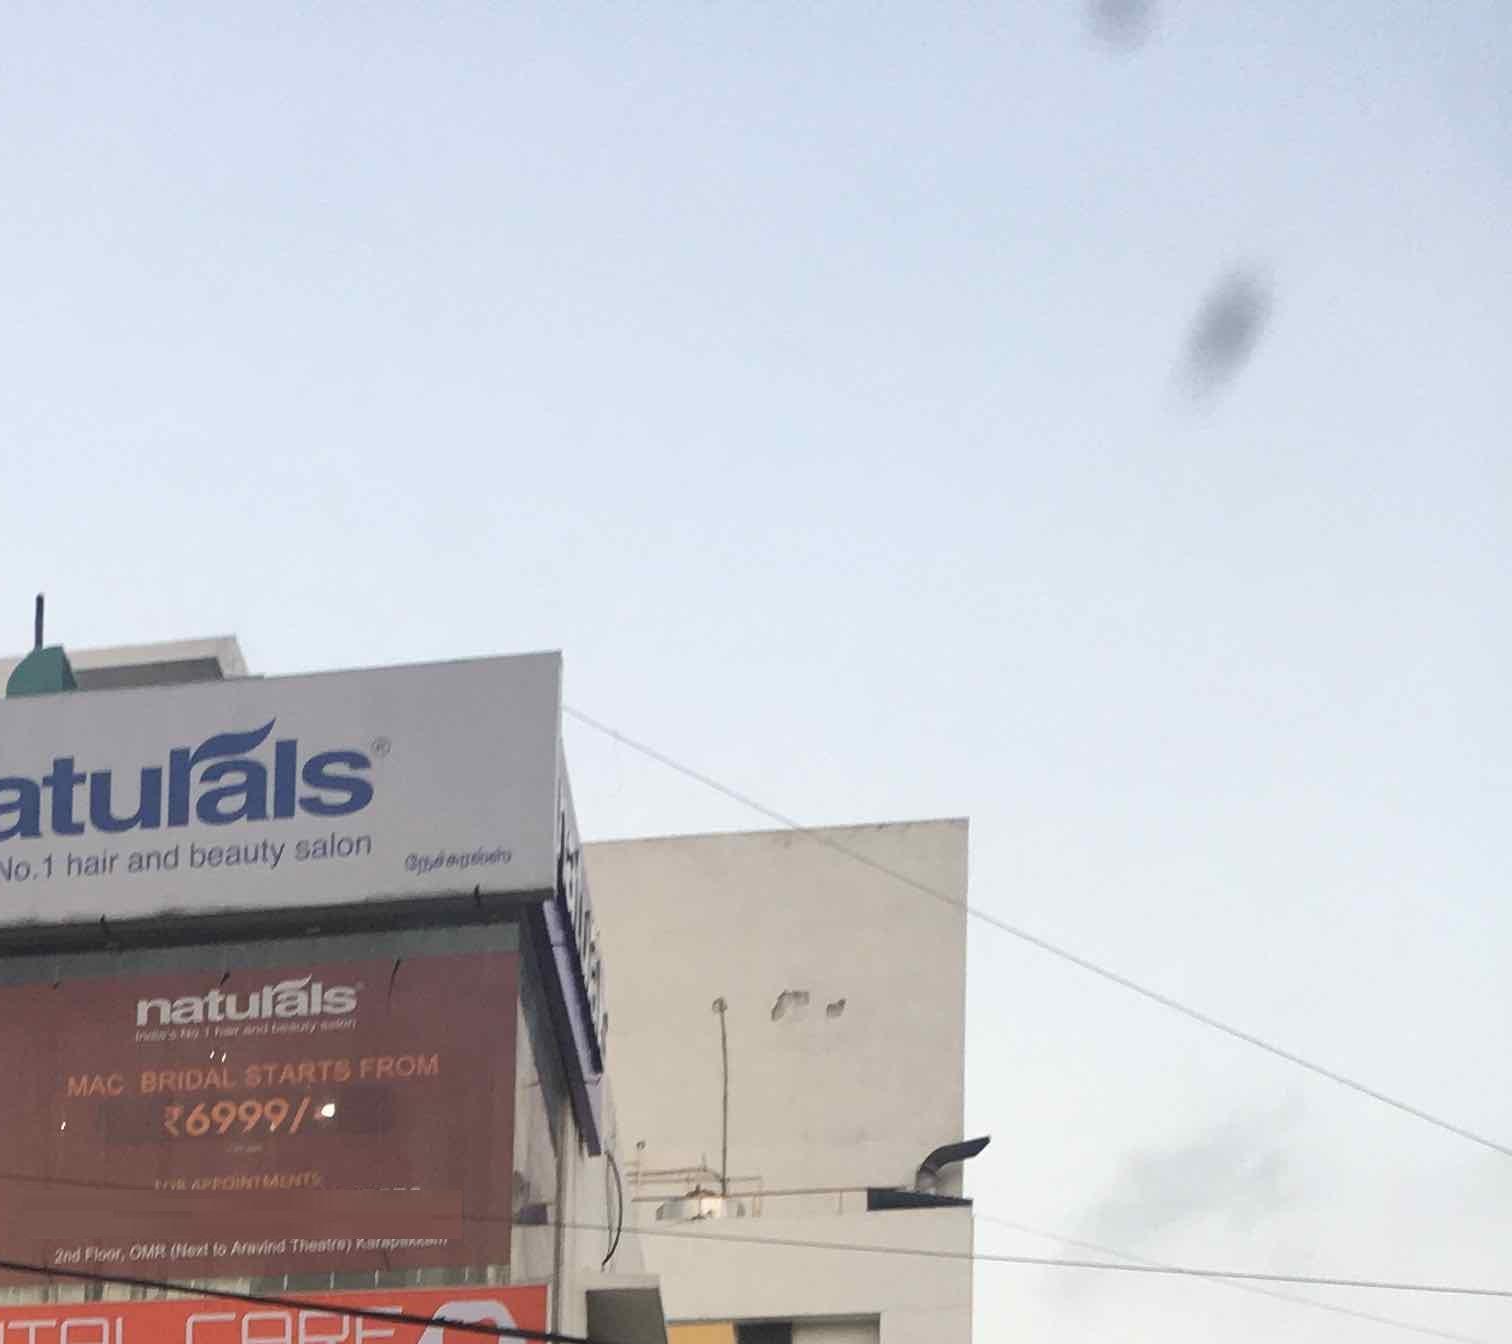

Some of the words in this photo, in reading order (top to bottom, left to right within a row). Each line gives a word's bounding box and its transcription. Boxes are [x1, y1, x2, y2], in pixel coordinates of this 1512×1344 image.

[66, 849, 120, 877] hair
[128, 845, 180, 873] and
[189, 838, 286, 870] beauty
[295, 832, 373, 861] salon
[135, 974, 358, 1027] naturals
[66, 1073, 126, 1098] MAC
[140, 1067, 238, 1094] BRIDAL
[244, 1058, 352, 1089] STARTS
[359, 1053, 440, 1080] FROM
[54, 1246, 81, 1264] 2nd
[213, 1242, 228, 1257] to
[231, 1239, 287, 1256] Aravind
